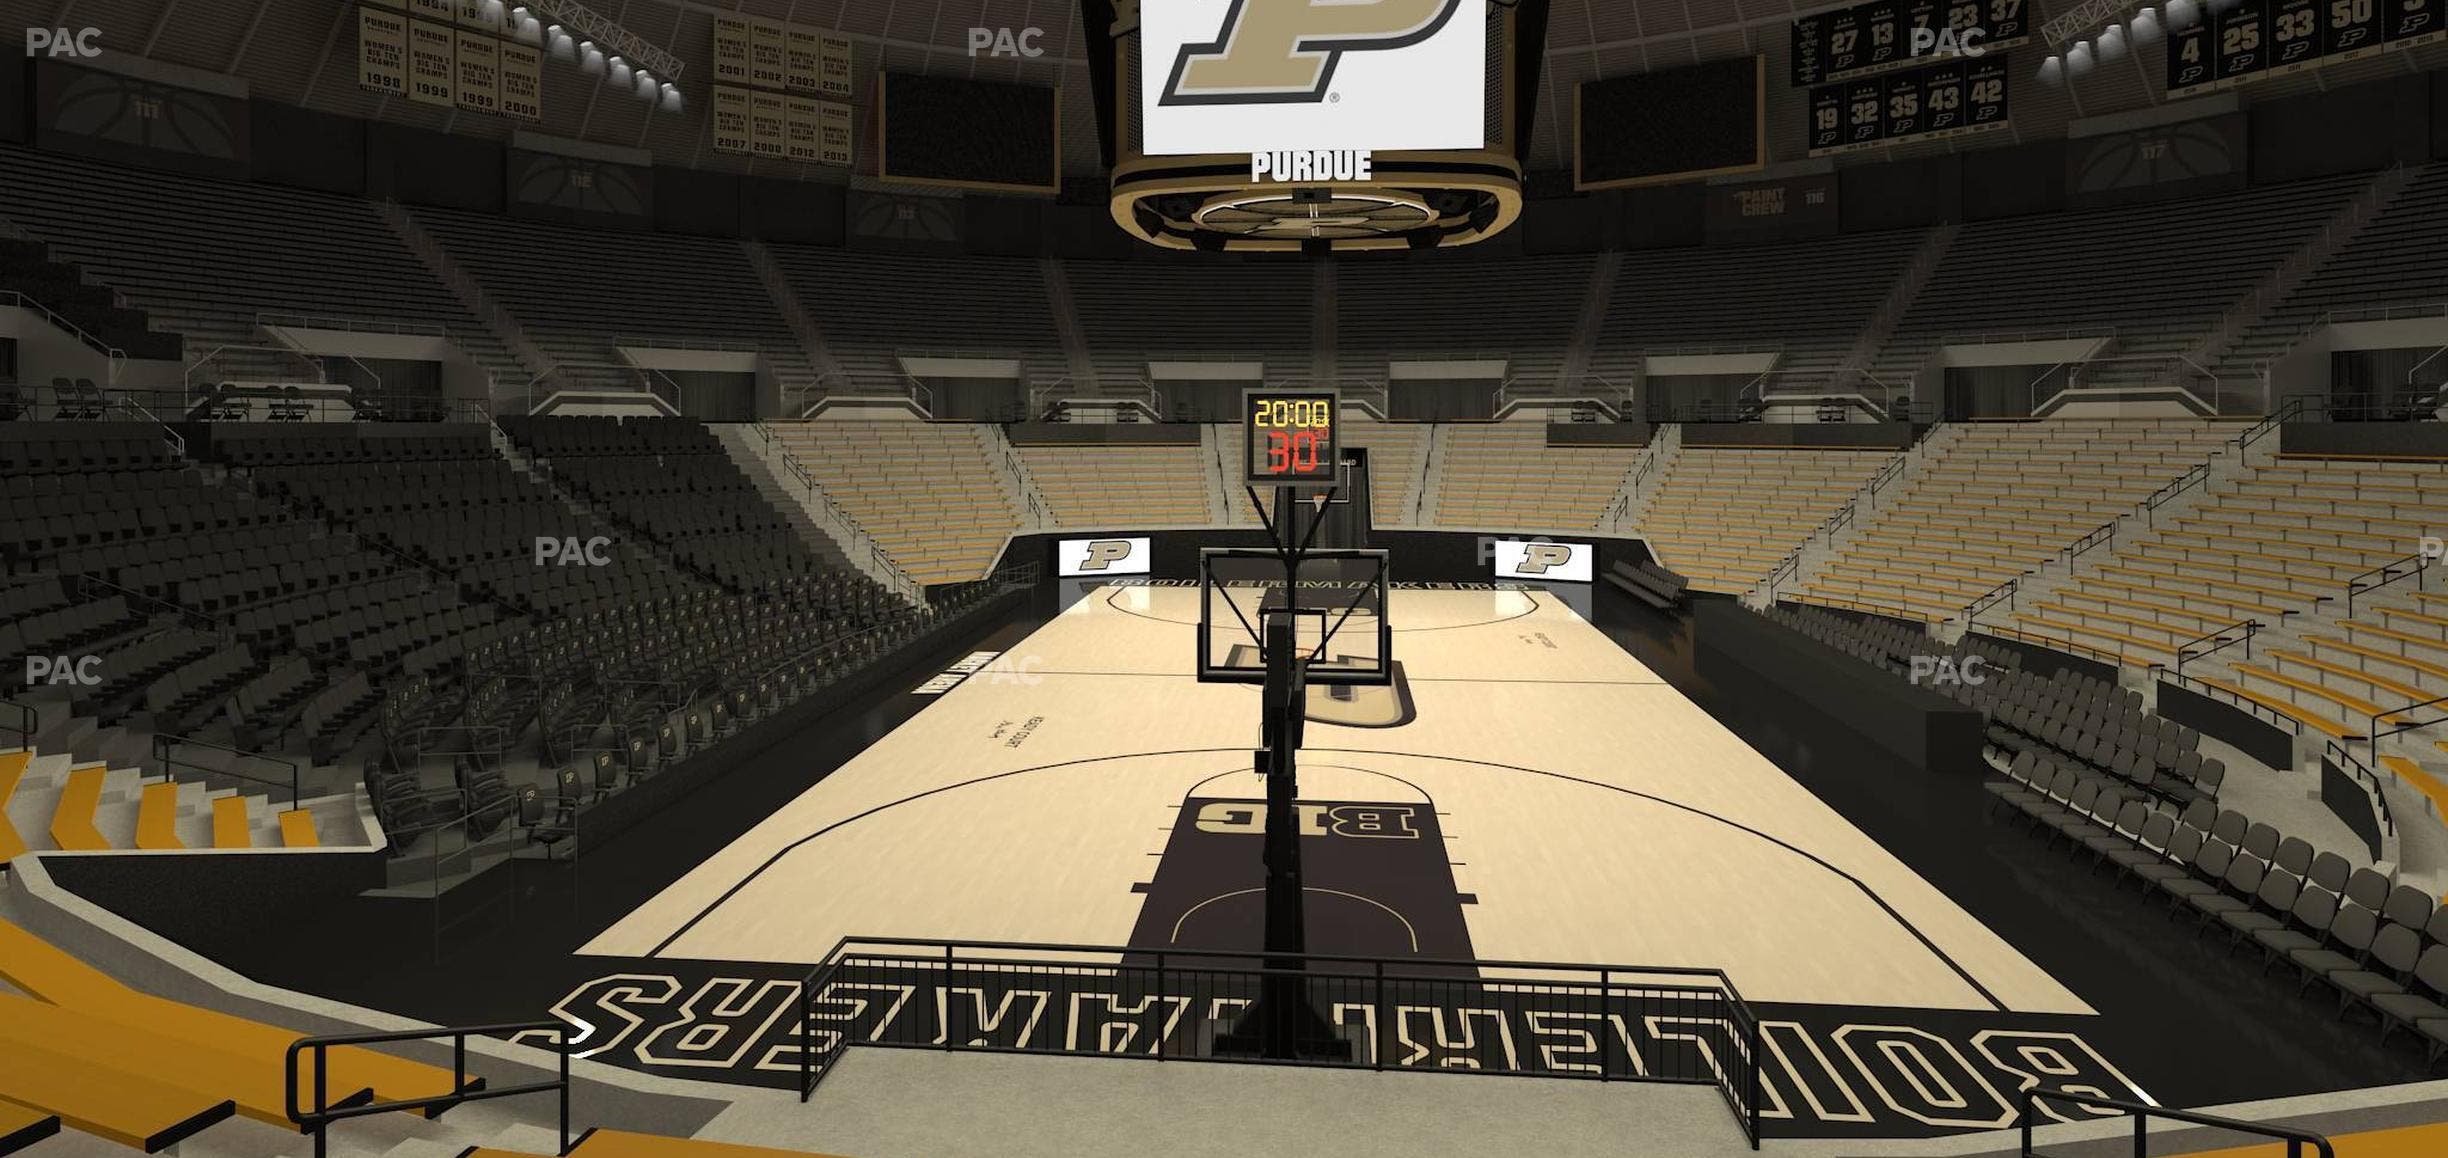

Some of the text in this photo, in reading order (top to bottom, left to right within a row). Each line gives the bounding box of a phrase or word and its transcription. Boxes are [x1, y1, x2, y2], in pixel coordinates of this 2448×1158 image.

[1948, 4, 1978, 30] 23
[1989, 0, 2021, 22] 37
[2331, 0, 2373, 29] 50
[365, 16, 400, 31] PURDUE
[414, 28, 448, 43] PURDUE
[1871, 22, 1894, 46] 13
[2275, 9, 2315, 43] 33
[460, 39, 493, 53] PURDUE
[1831, 30, 1859, 54] 27
[2181, 37, 2200, 63] 4
[2222, 22, 2260, 56] 25
[505, 50, 536, 63] PURDUE
[367, 72, 400, 88] 1998
[416, 83, 448, 98] 1999
[1970, 79, 2003, 103] 42
[463, 92, 493, 107] 1999
[505, 101, 537, 116] 2000
[1889, 93, 1918, 118] 35
[1928, 87, 1960, 111] 43
[1816, 108, 1838, 130] 19
[1851, 101, 1878, 124] 32
[1251, 149, 1372, 183] PURDUE
[1254, 400, 1329, 427] 20:00
[1268, 431, 1317, 472] 30
[1079, 540, 1132, 571] P
[1516, 543, 1572, 574] P
[507, 972, 2162, 1129] BOILERAKERS
